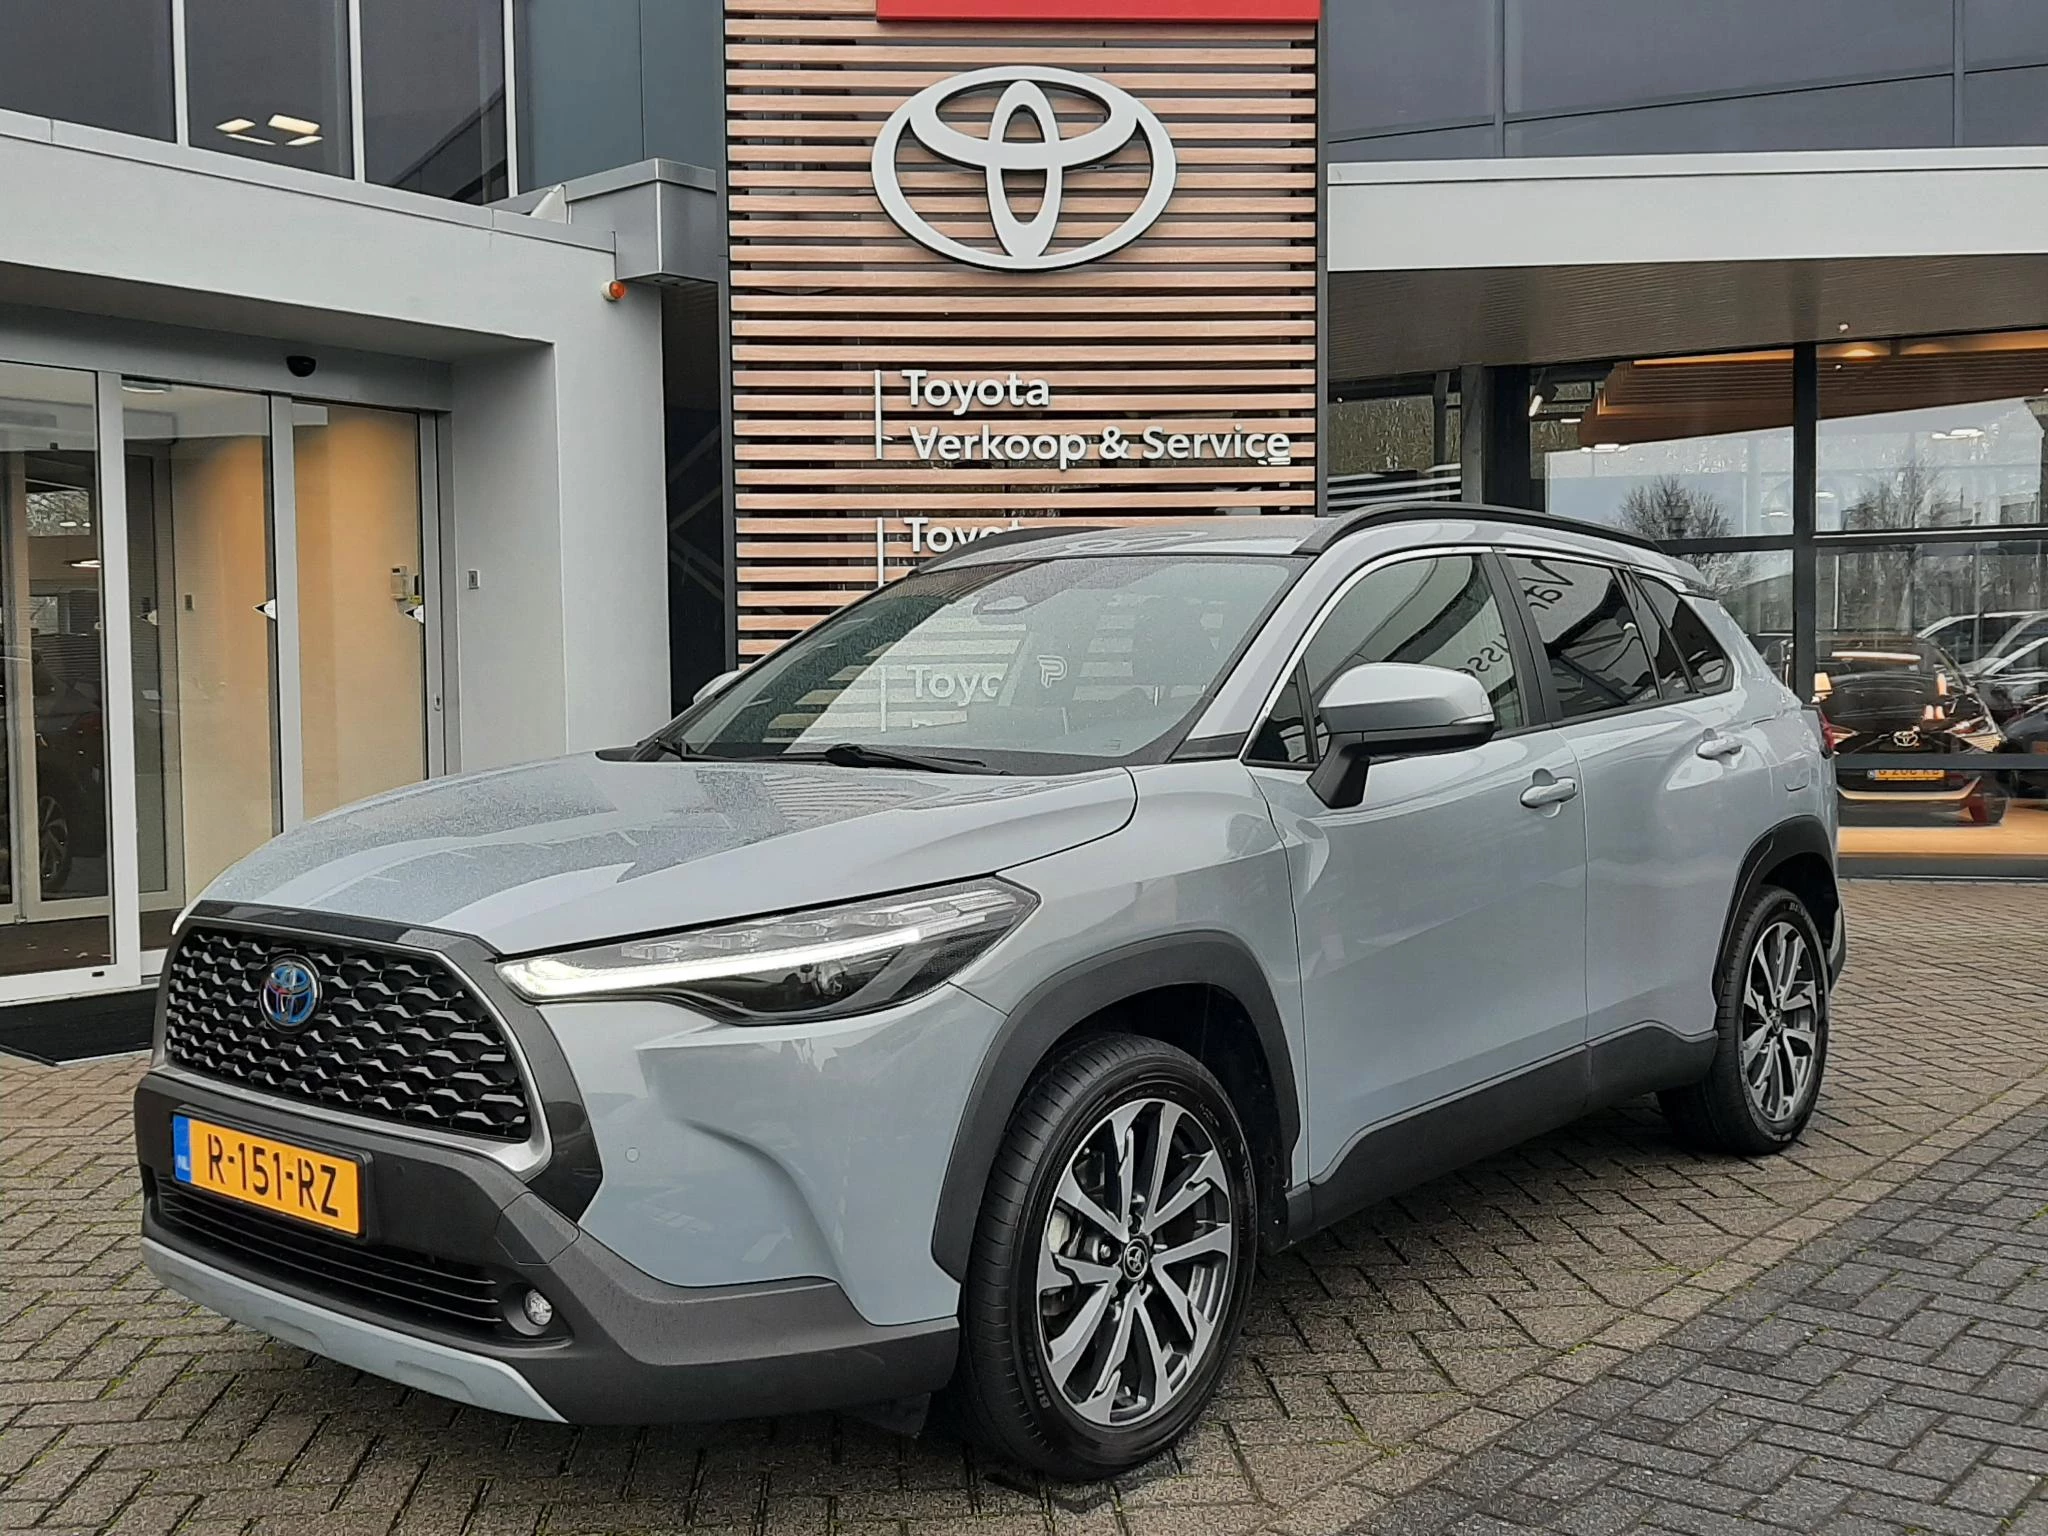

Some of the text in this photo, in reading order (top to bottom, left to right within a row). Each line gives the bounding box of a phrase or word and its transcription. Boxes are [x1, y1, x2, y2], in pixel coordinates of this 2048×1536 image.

[901, 369, 1050, 415] Toyota
[909, 423, 1290, 471] Verkoop & Service
[207, 1134, 339, 1218] R-151-RZ
